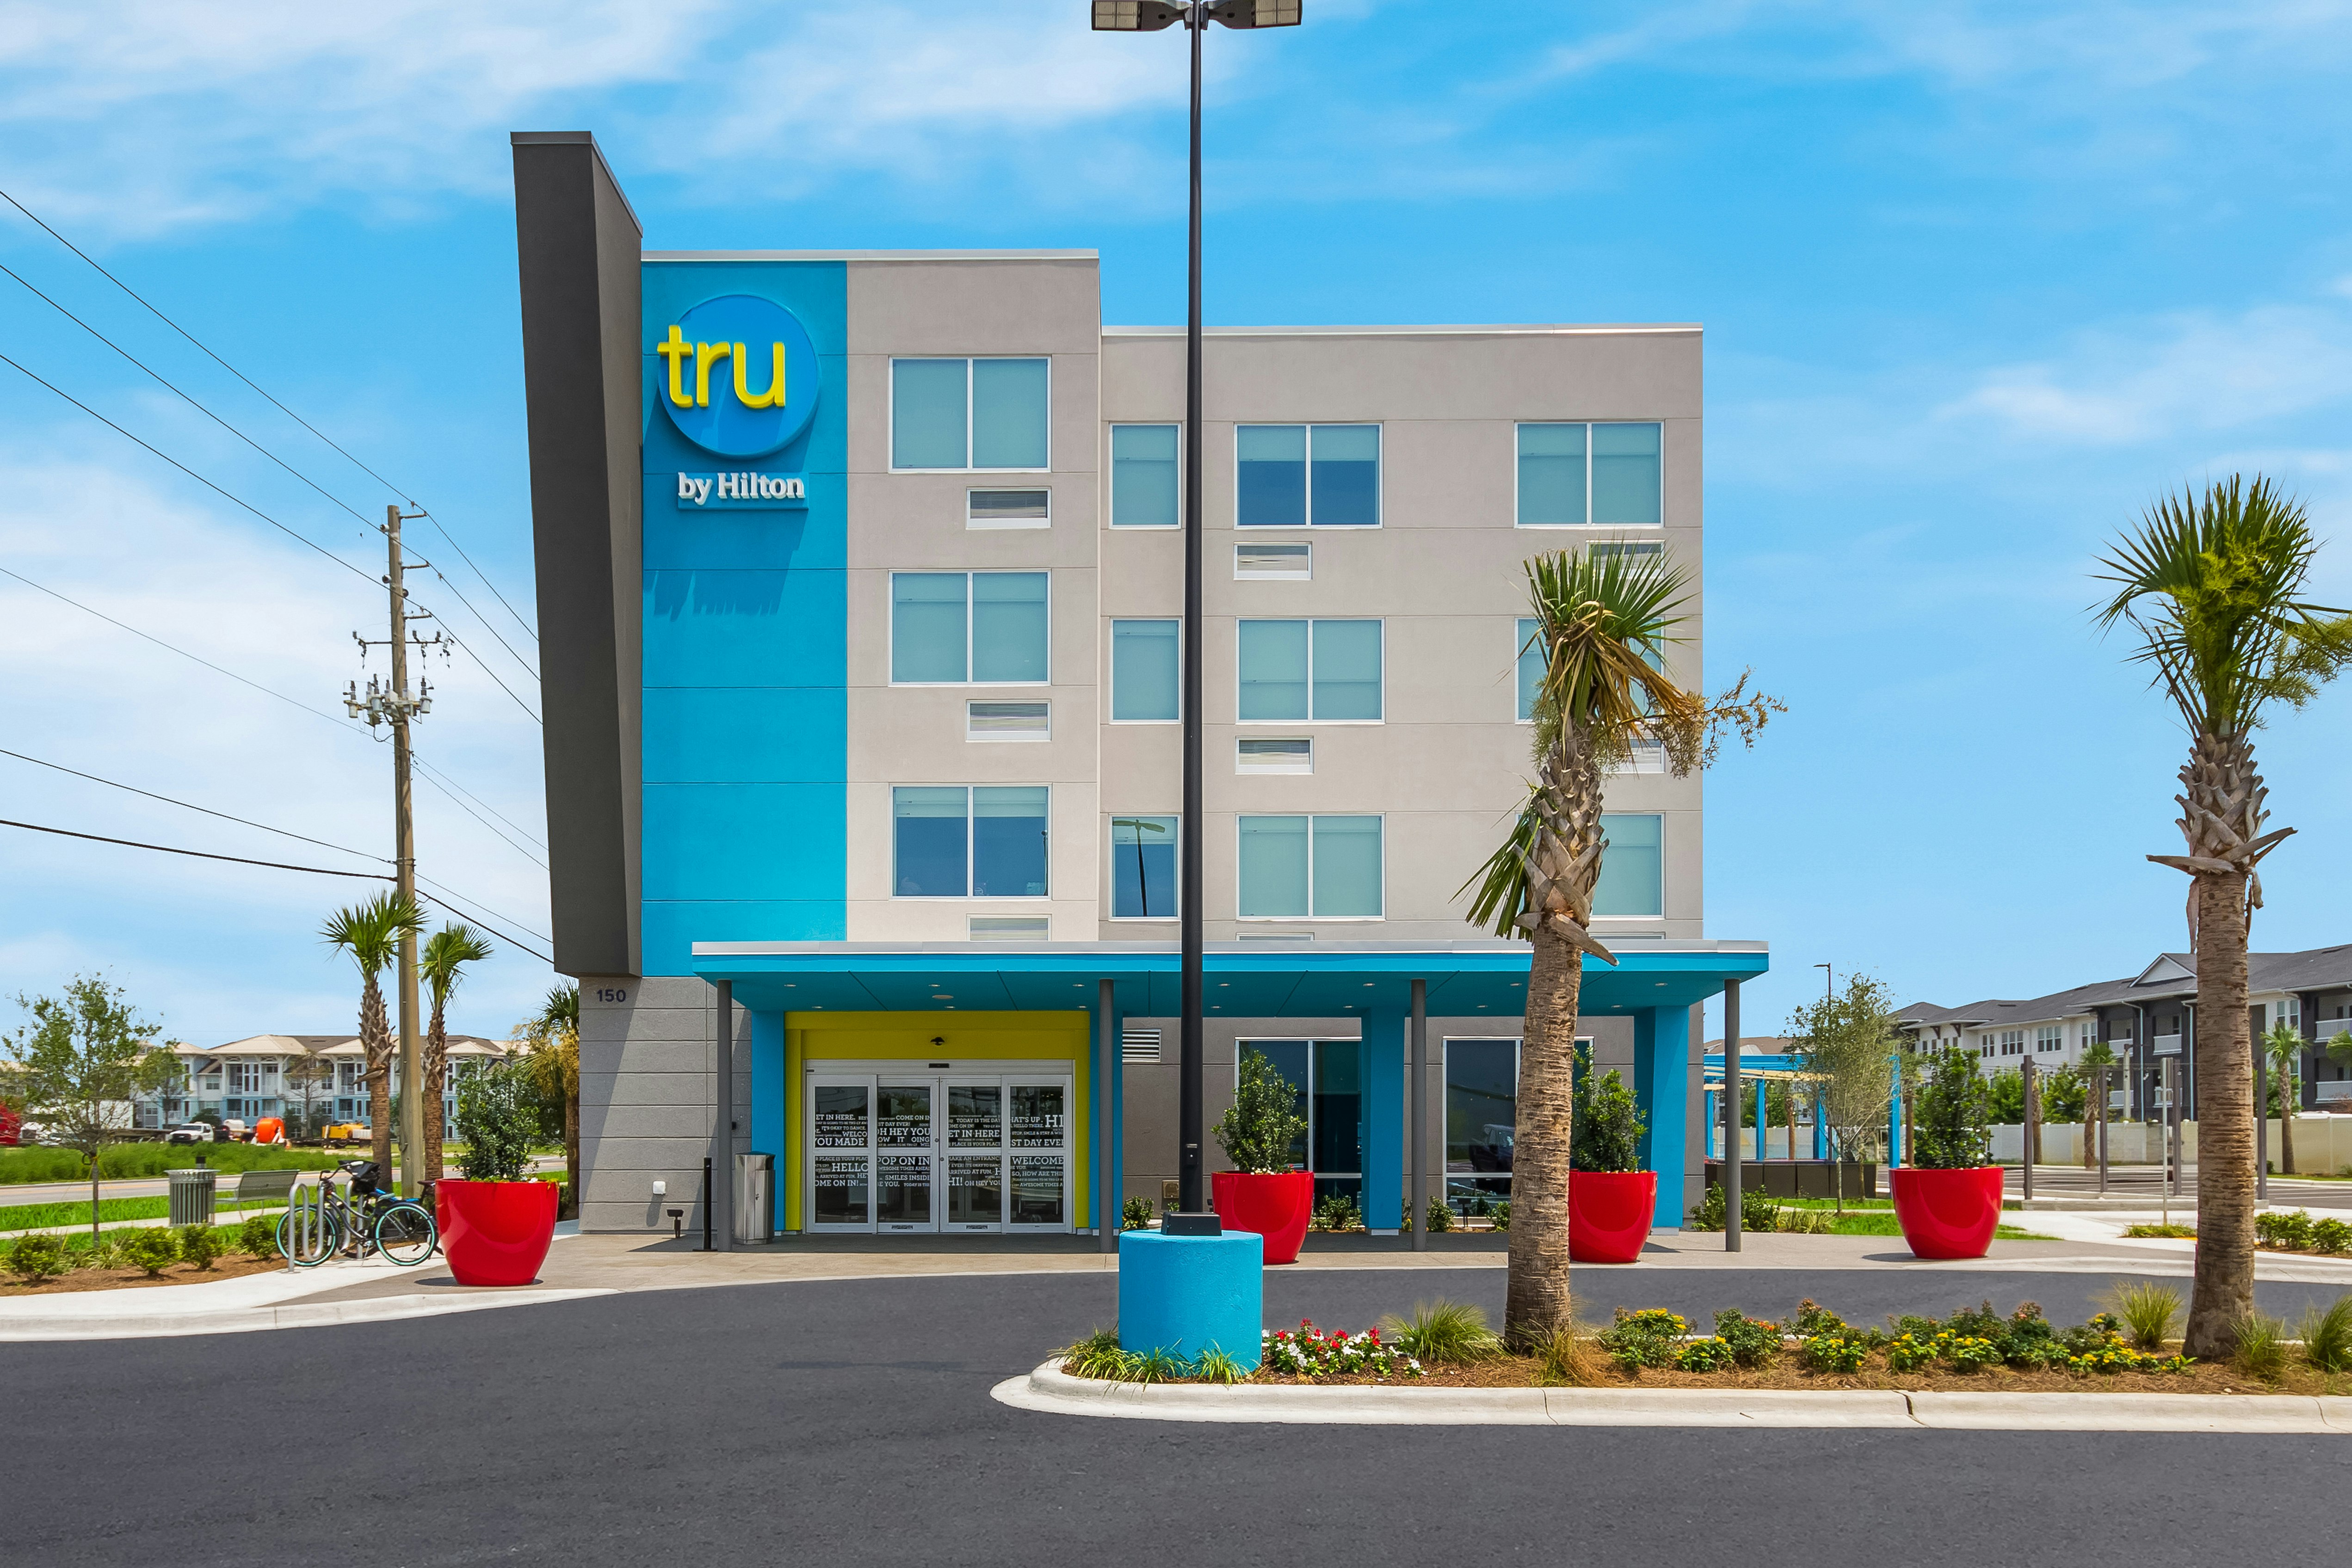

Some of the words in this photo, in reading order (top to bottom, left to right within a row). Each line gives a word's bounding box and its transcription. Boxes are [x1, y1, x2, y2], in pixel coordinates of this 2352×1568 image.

[657, 325, 785, 408] tru
[678, 472, 713, 505] by
[717, 472, 805, 499] Hilton
[597, 989, 626, 1002] 150
[832, 1163, 869, 1172] HELLO
